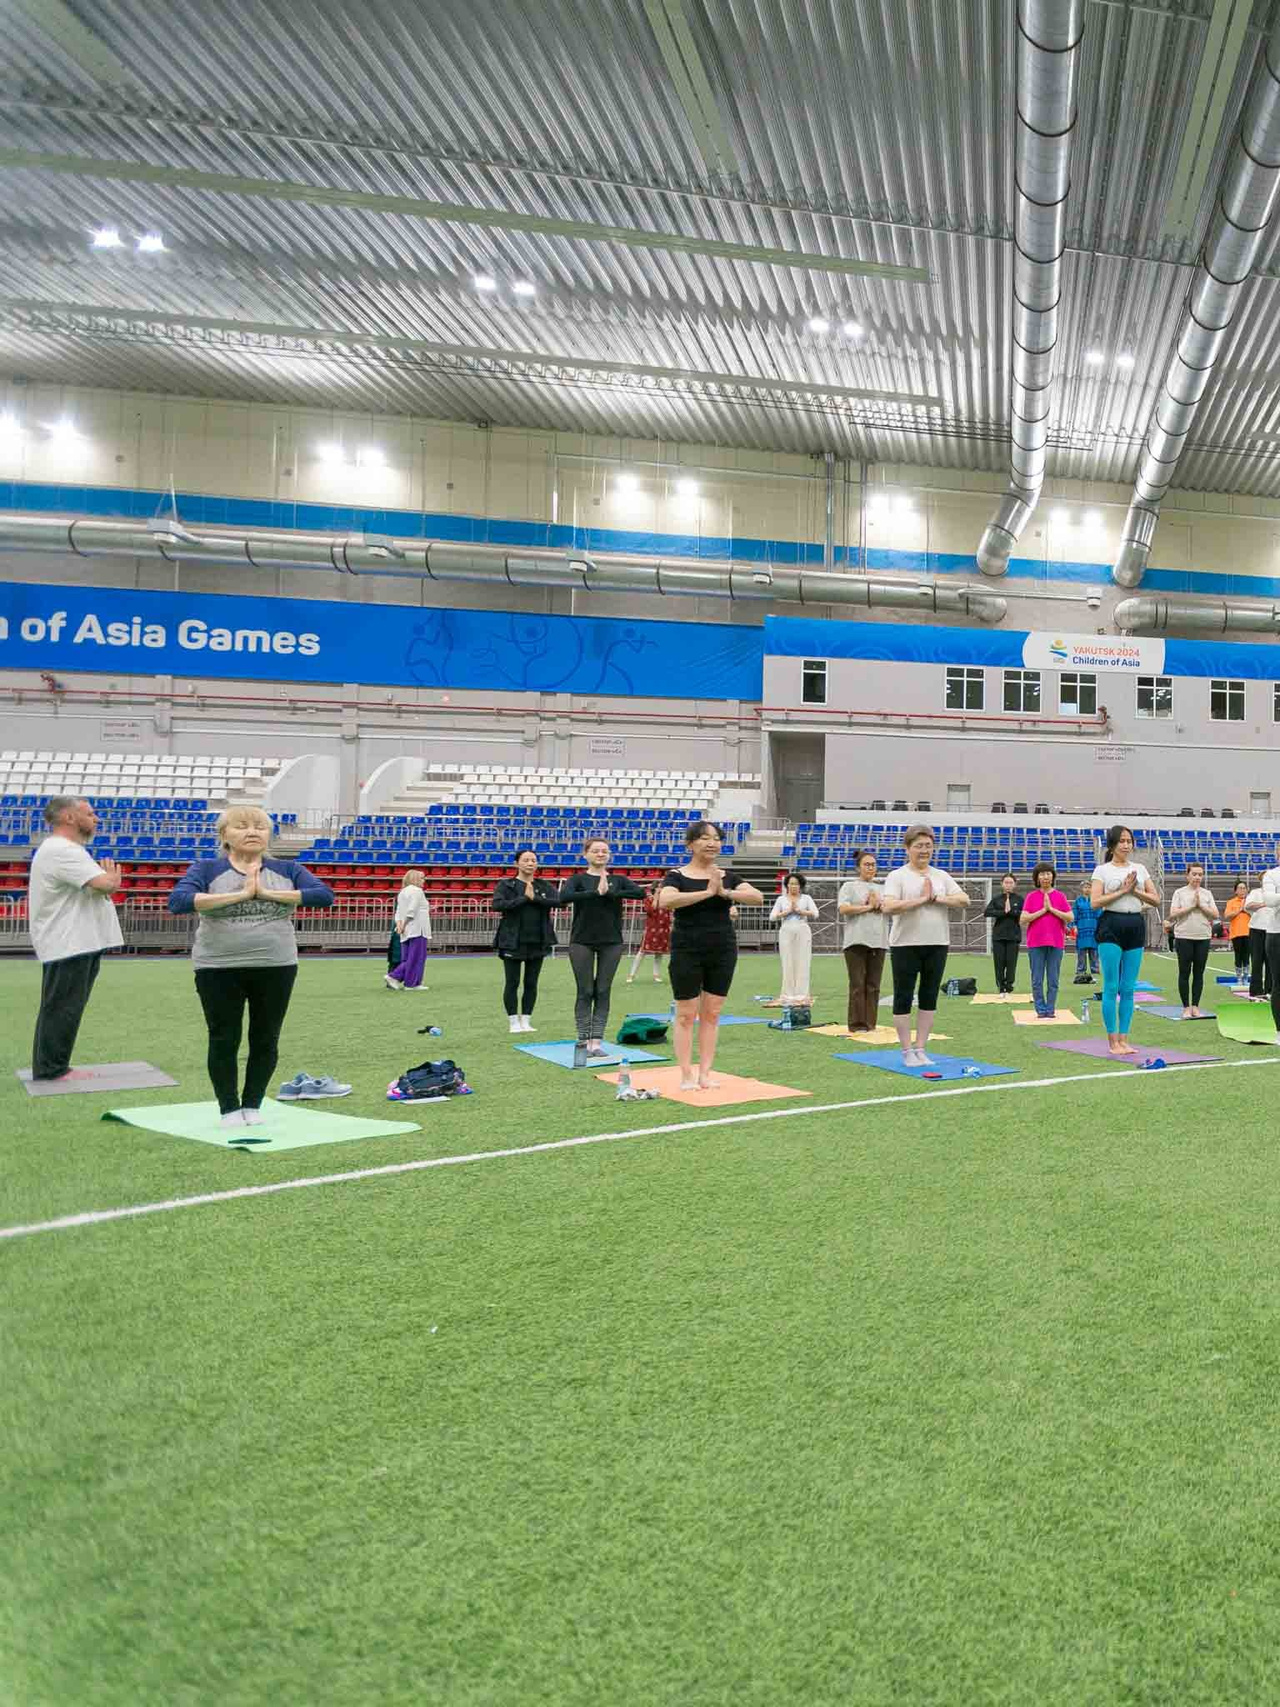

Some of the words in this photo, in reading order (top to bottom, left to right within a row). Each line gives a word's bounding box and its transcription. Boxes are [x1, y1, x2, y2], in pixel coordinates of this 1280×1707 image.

[20, 611, 67, 642] of
[73, 614, 166, 647] Asia
[178, 619, 321, 656] Games
[1073, 646, 1115, 657] YAKUTSK
[1117, 648, 1140, 657] 2024
[1072, 656, 1109, 666] Children
[1111, 657, 1120, 667] of
[1121, 658, 1140, 667] Asia
